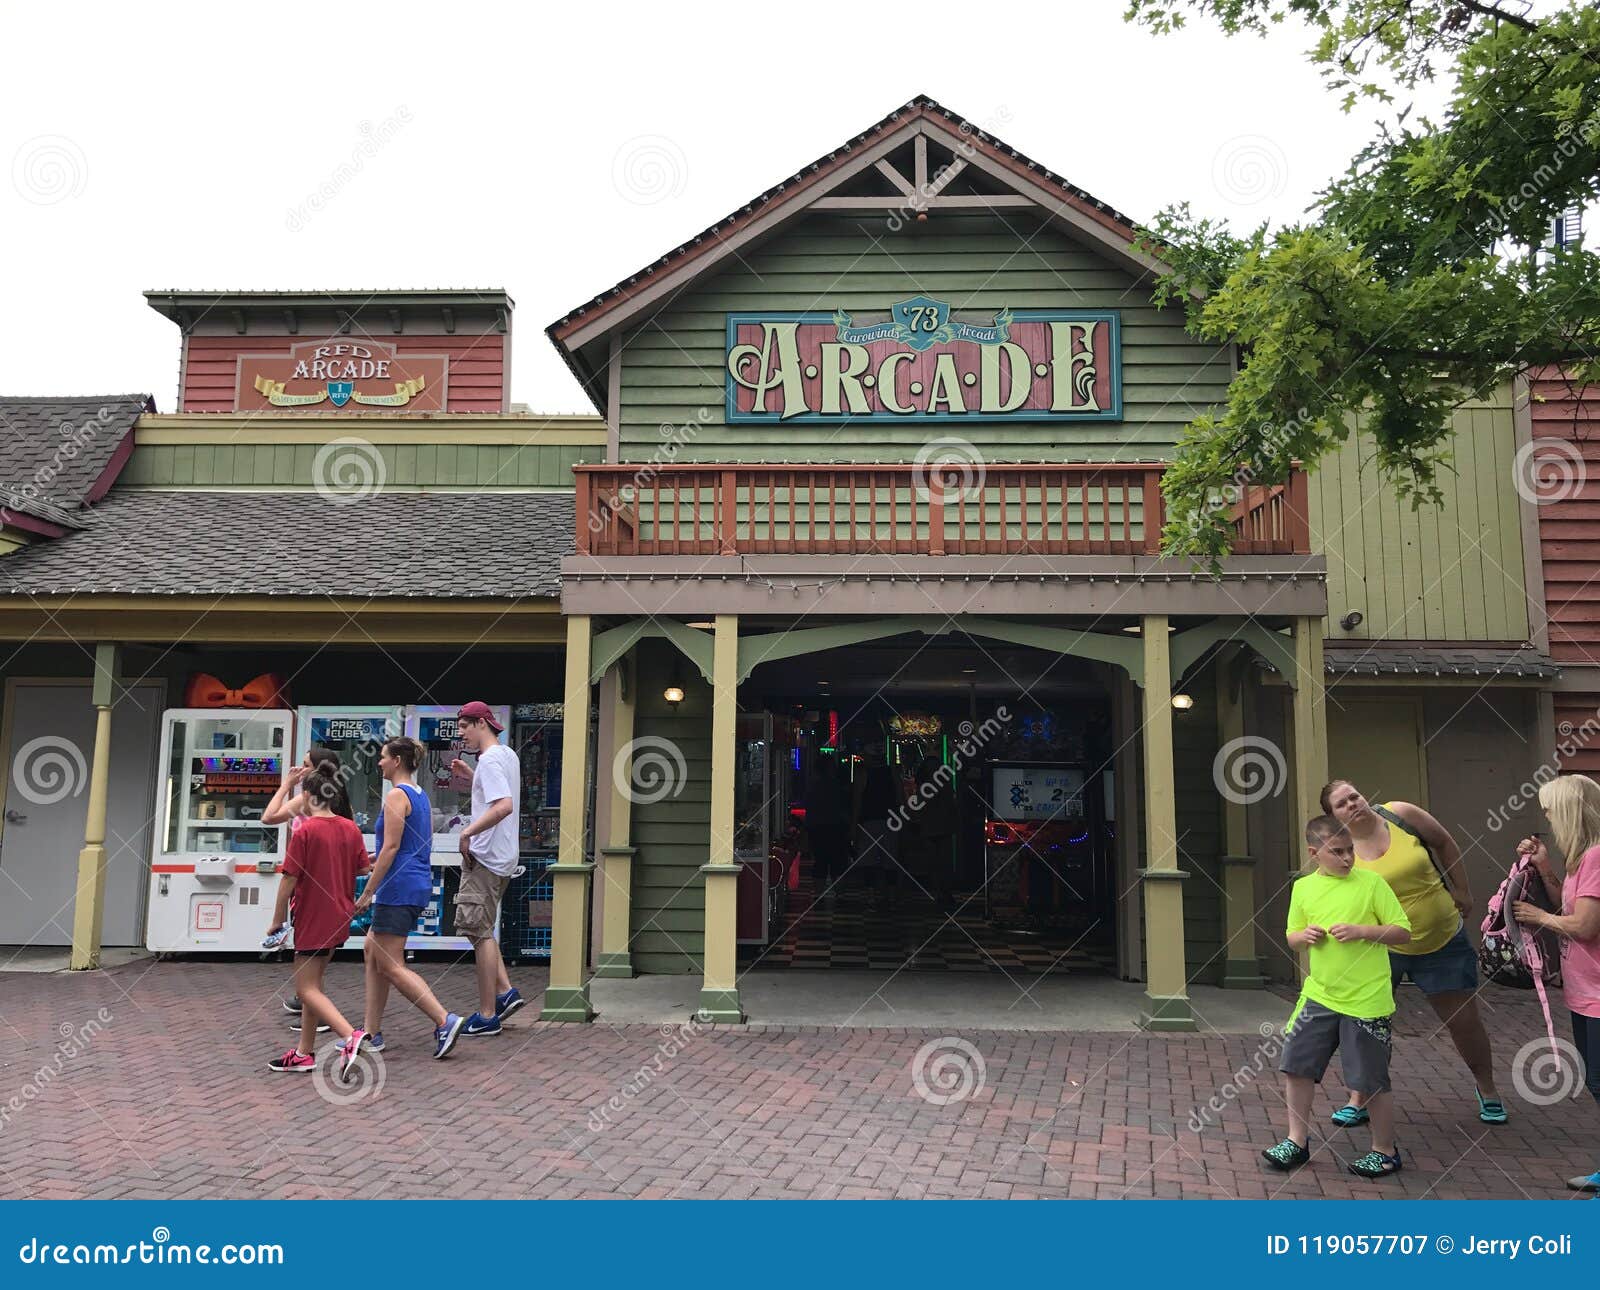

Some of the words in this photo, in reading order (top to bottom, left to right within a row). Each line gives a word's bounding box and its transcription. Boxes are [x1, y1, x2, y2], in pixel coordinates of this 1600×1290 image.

[843, 327, 900, 342] Carowinds
[314, 344, 372, 360] RFD
[292, 360, 391, 380] ARCADE
[331, 720, 363, 729] PRIZE
[439, 720, 458, 729] PRI
[331, 730, 360, 738] CUBE
[439, 729, 460, 738] CUB
